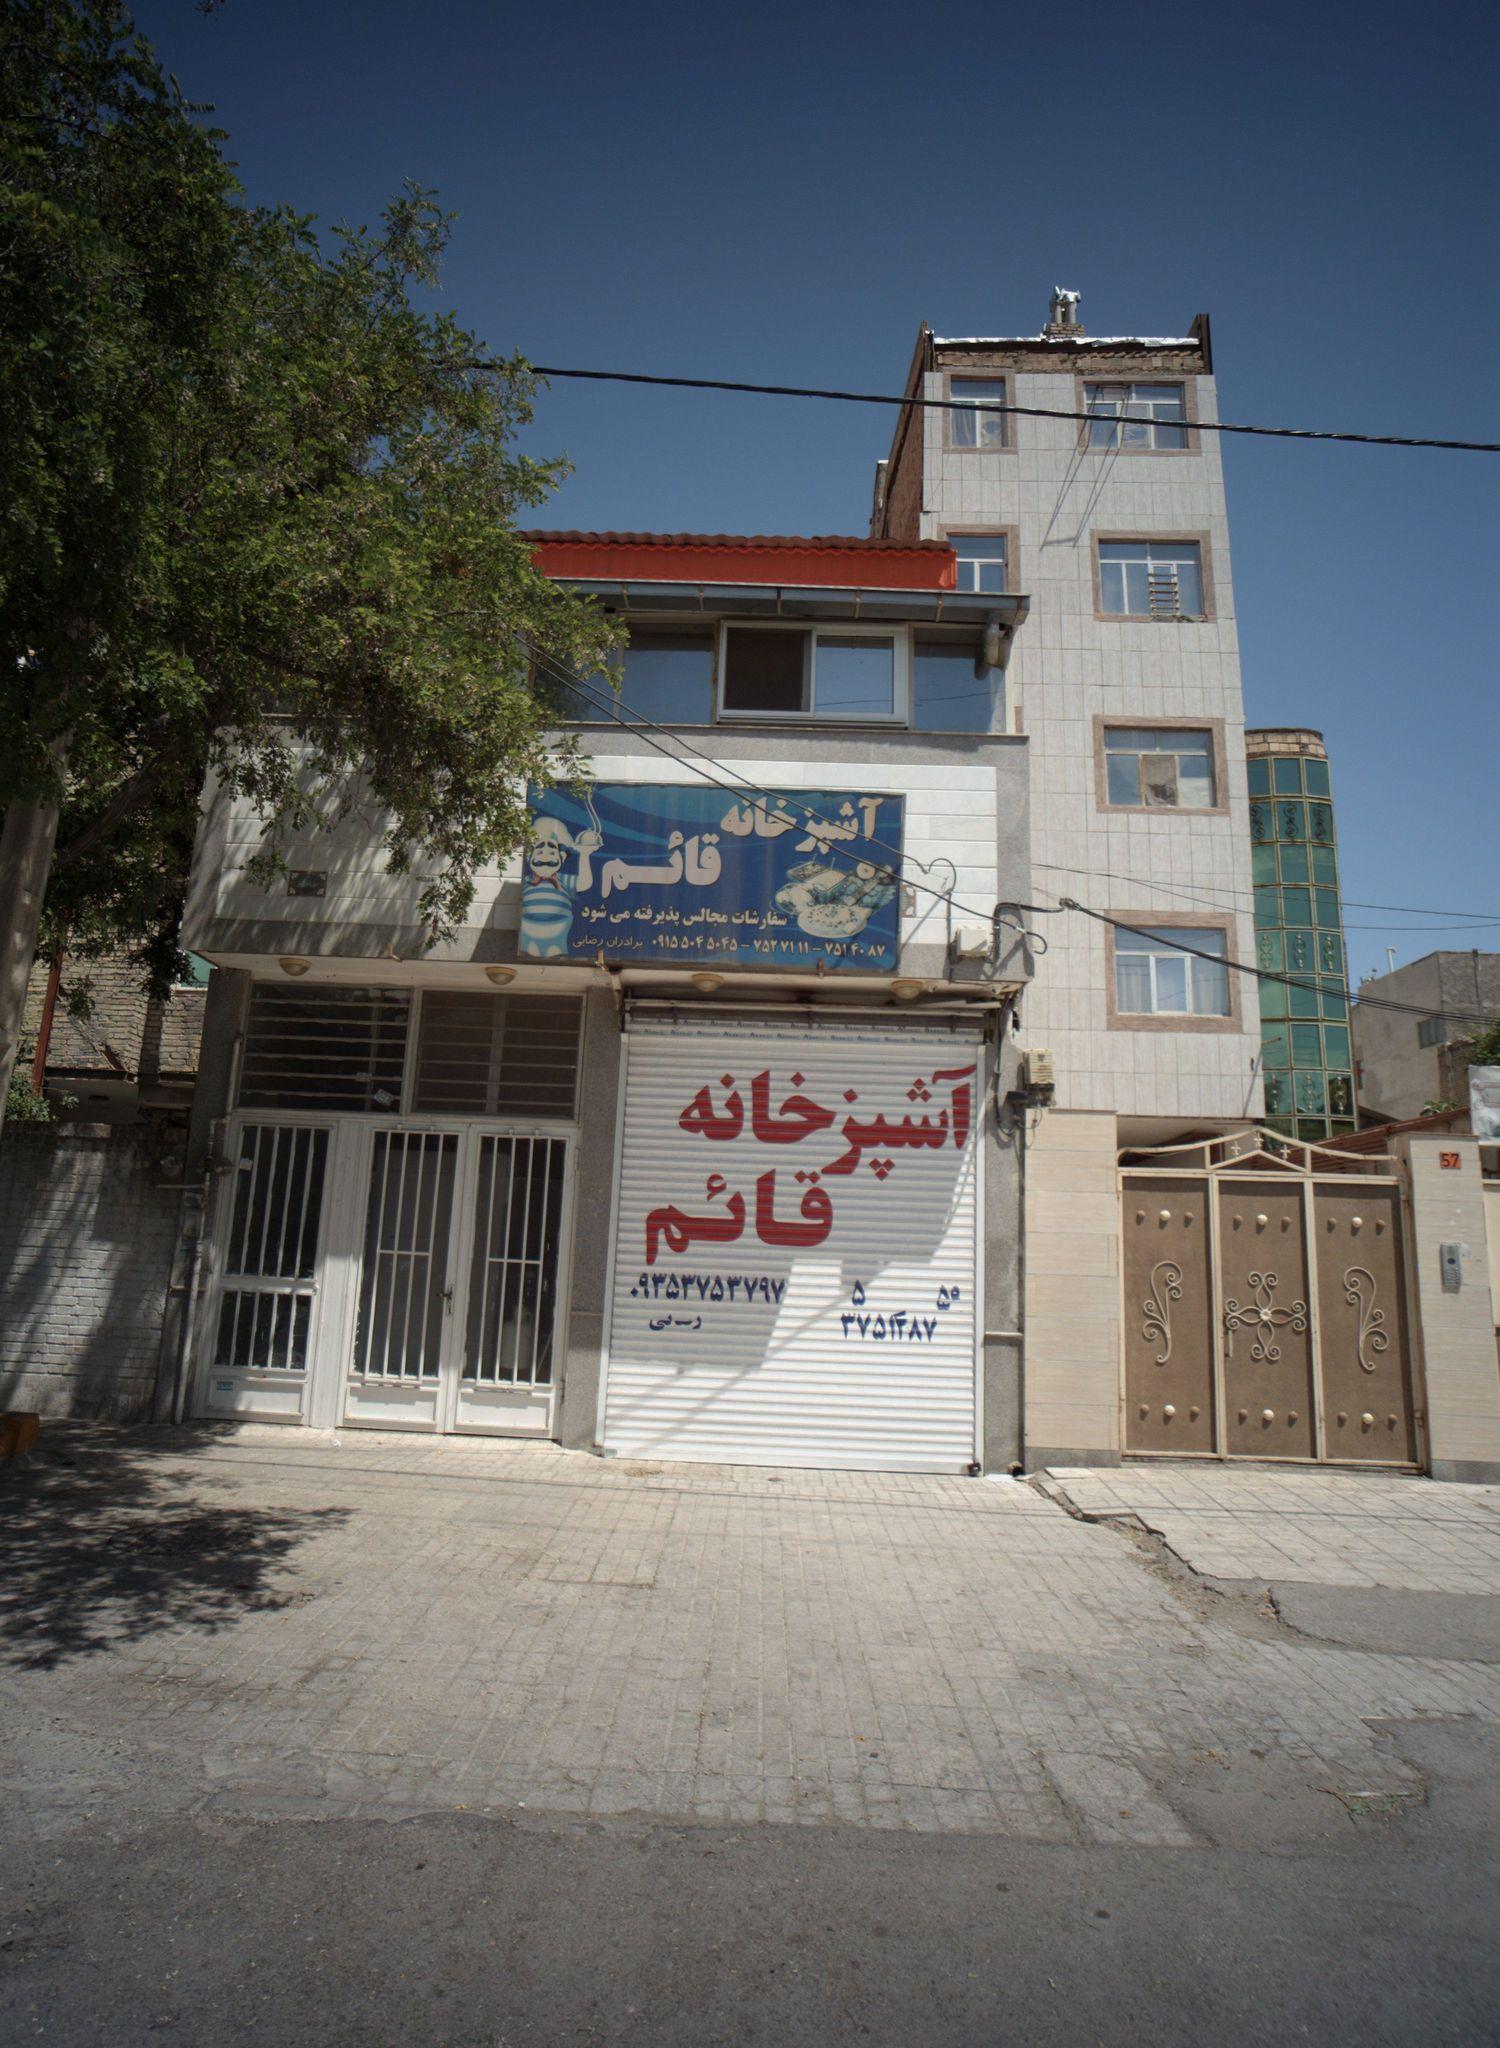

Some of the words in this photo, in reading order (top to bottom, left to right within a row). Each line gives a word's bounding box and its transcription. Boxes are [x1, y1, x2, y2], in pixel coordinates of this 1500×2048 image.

[720, 797, 884, 854] آشپزخانه
[601, 831, 722, 898] قائم
[581, 904, 606, 923] شود
[609, 908, 630, 923] می
[634, 904, 680, 926] پذیرفته
[682, 907, 728, 926] مجالس
[732, 909, 787, 930] سفارشات
[606, 936, 643, 949] برادران
[679, 1064, 976, 1181] آشپزخانه
[1441, 1153, 1459, 1168] 57
[646, 1168, 833, 1265] قائم
